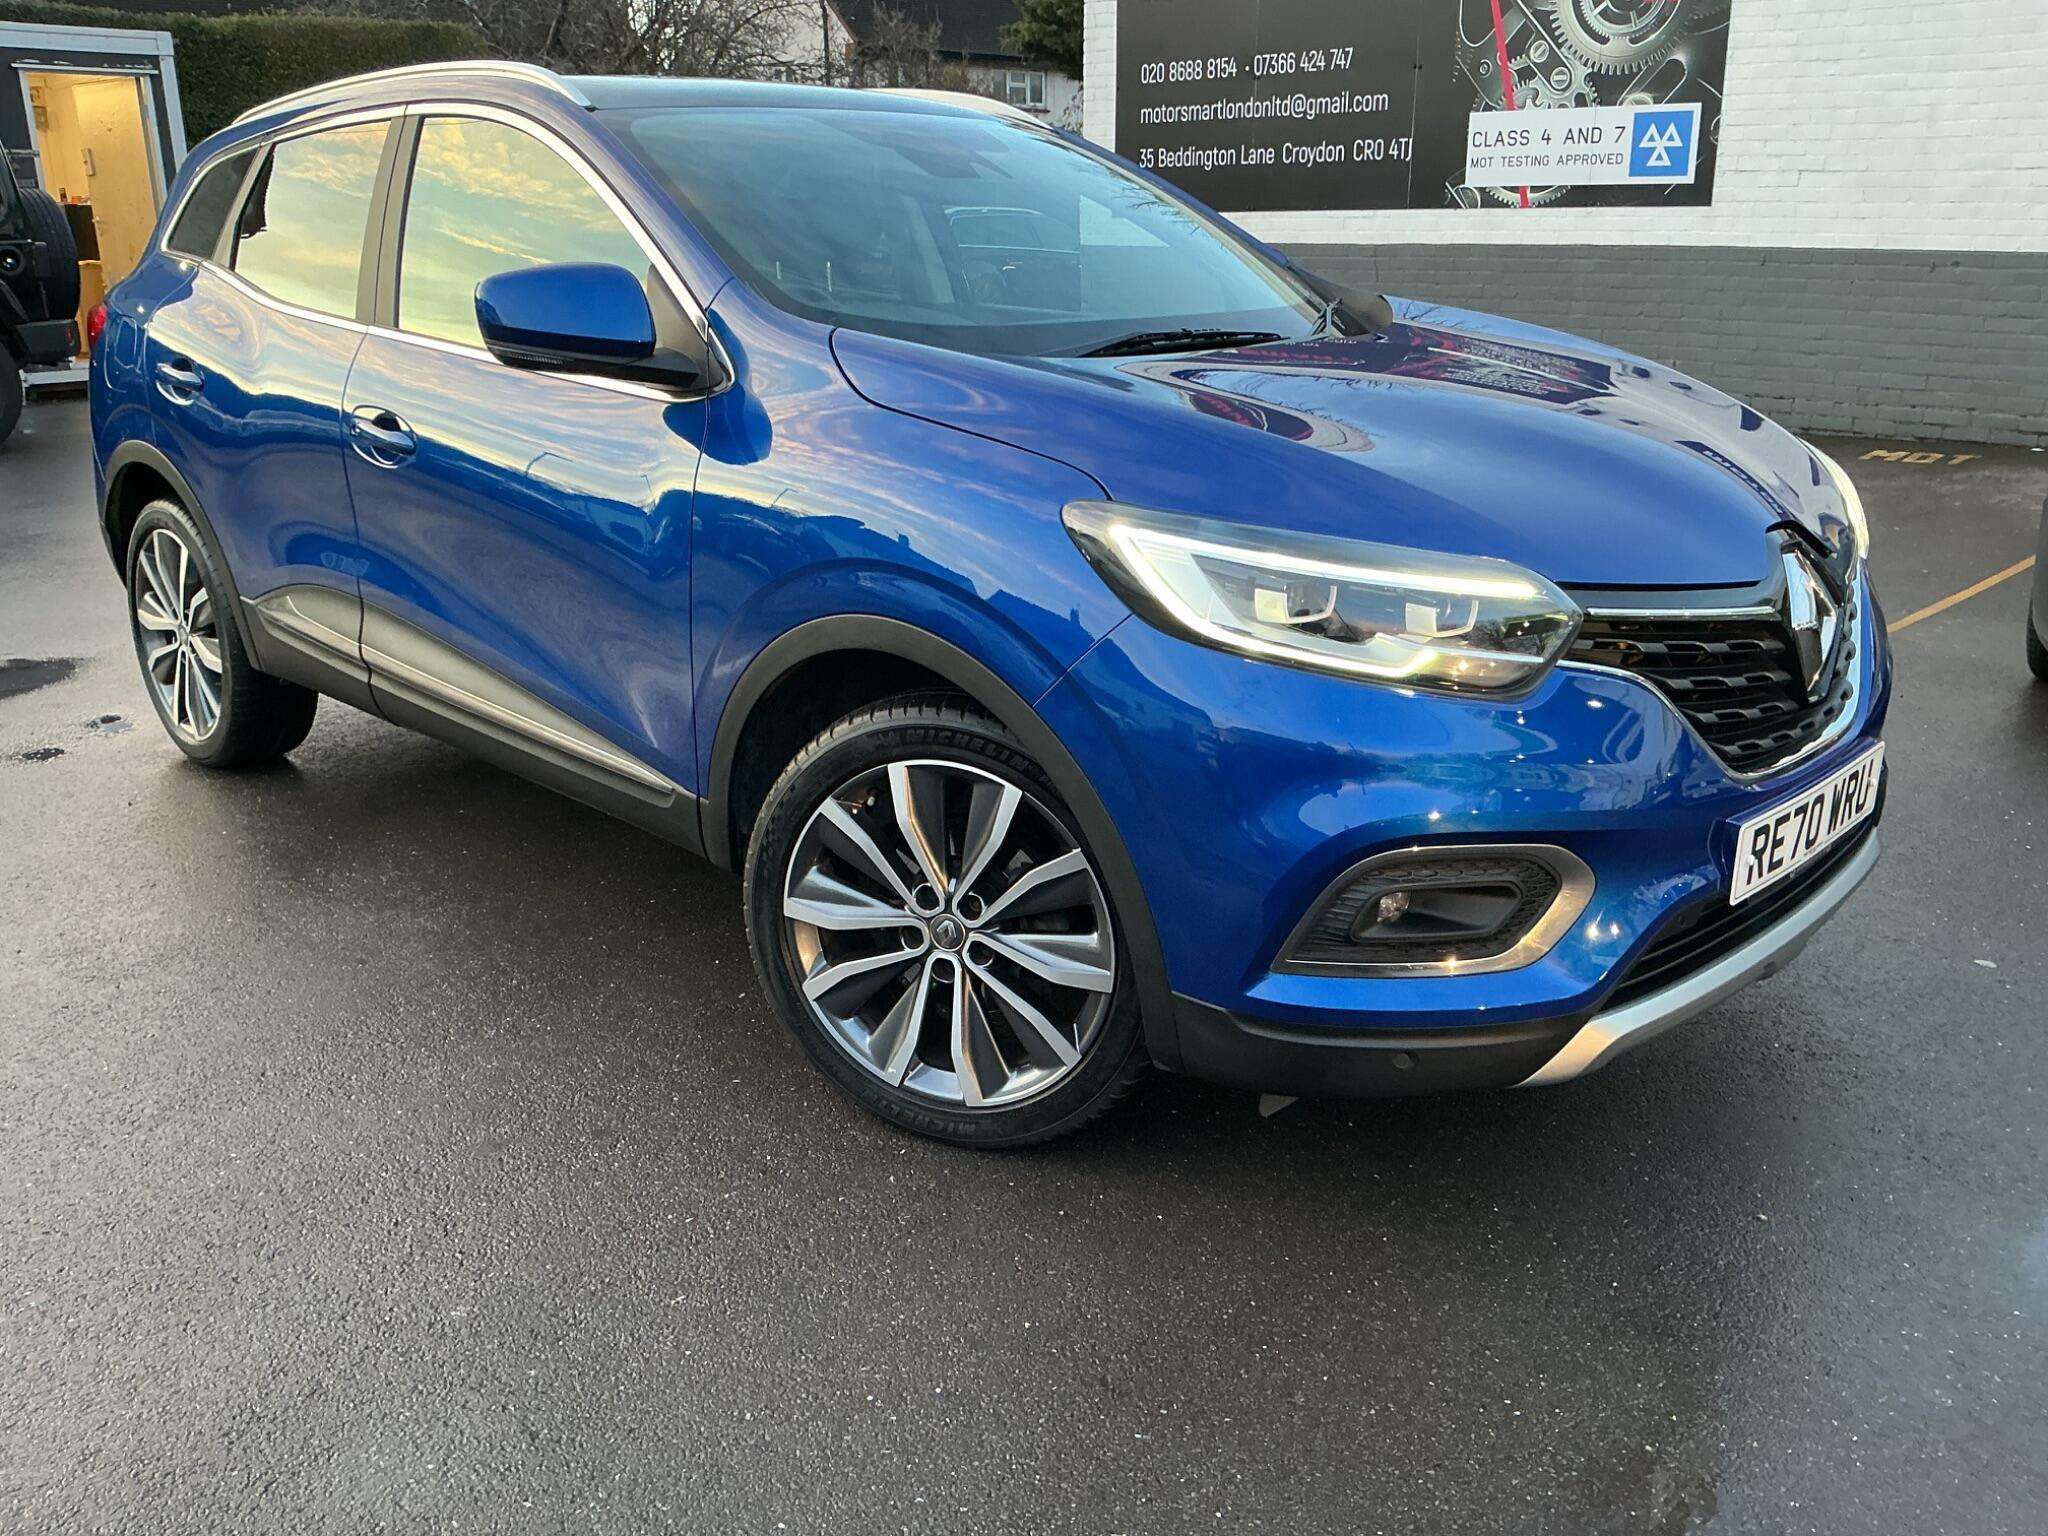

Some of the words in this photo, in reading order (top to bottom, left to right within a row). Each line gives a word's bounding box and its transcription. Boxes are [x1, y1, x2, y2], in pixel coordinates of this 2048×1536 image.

[1140, 63, 1165, 84] 020
[1169, 60, 1203, 82] 8688
[1207, 57, 1238, 79] 8154
[1253, 53, 1296, 76] 07366
[1300, 50, 1326, 72] 424
[1329, 47, 1354, 70] 747
[1140, 90, 1389, 124] motorsmartlondonltd@gmail.com
[1139, 148, 1155, 168] 35
[1158, 146, 1236, 171] Beddington
[1240, 144, 1275, 165] Lane
[1282, 141, 1345, 168] Croydon
[1388, 137, 1414, 161] 4TJ
[1472, 129, 1530, 148] CLASS
[1541, 128, 1552, 146] 4
[1563, 126, 1603, 145] AND
[1614, 126, 1626, 143] 7
[1470, 156, 1494, 169] MOT
[1501, 155, 1550, 168] TESTING
[1556, 152, 1624, 166] APPROVED
[1858, 449, 1982, 465] MOT
[1746, 793, 1826, 886] RE70
[1827, 758, 1874, 836] WRU
